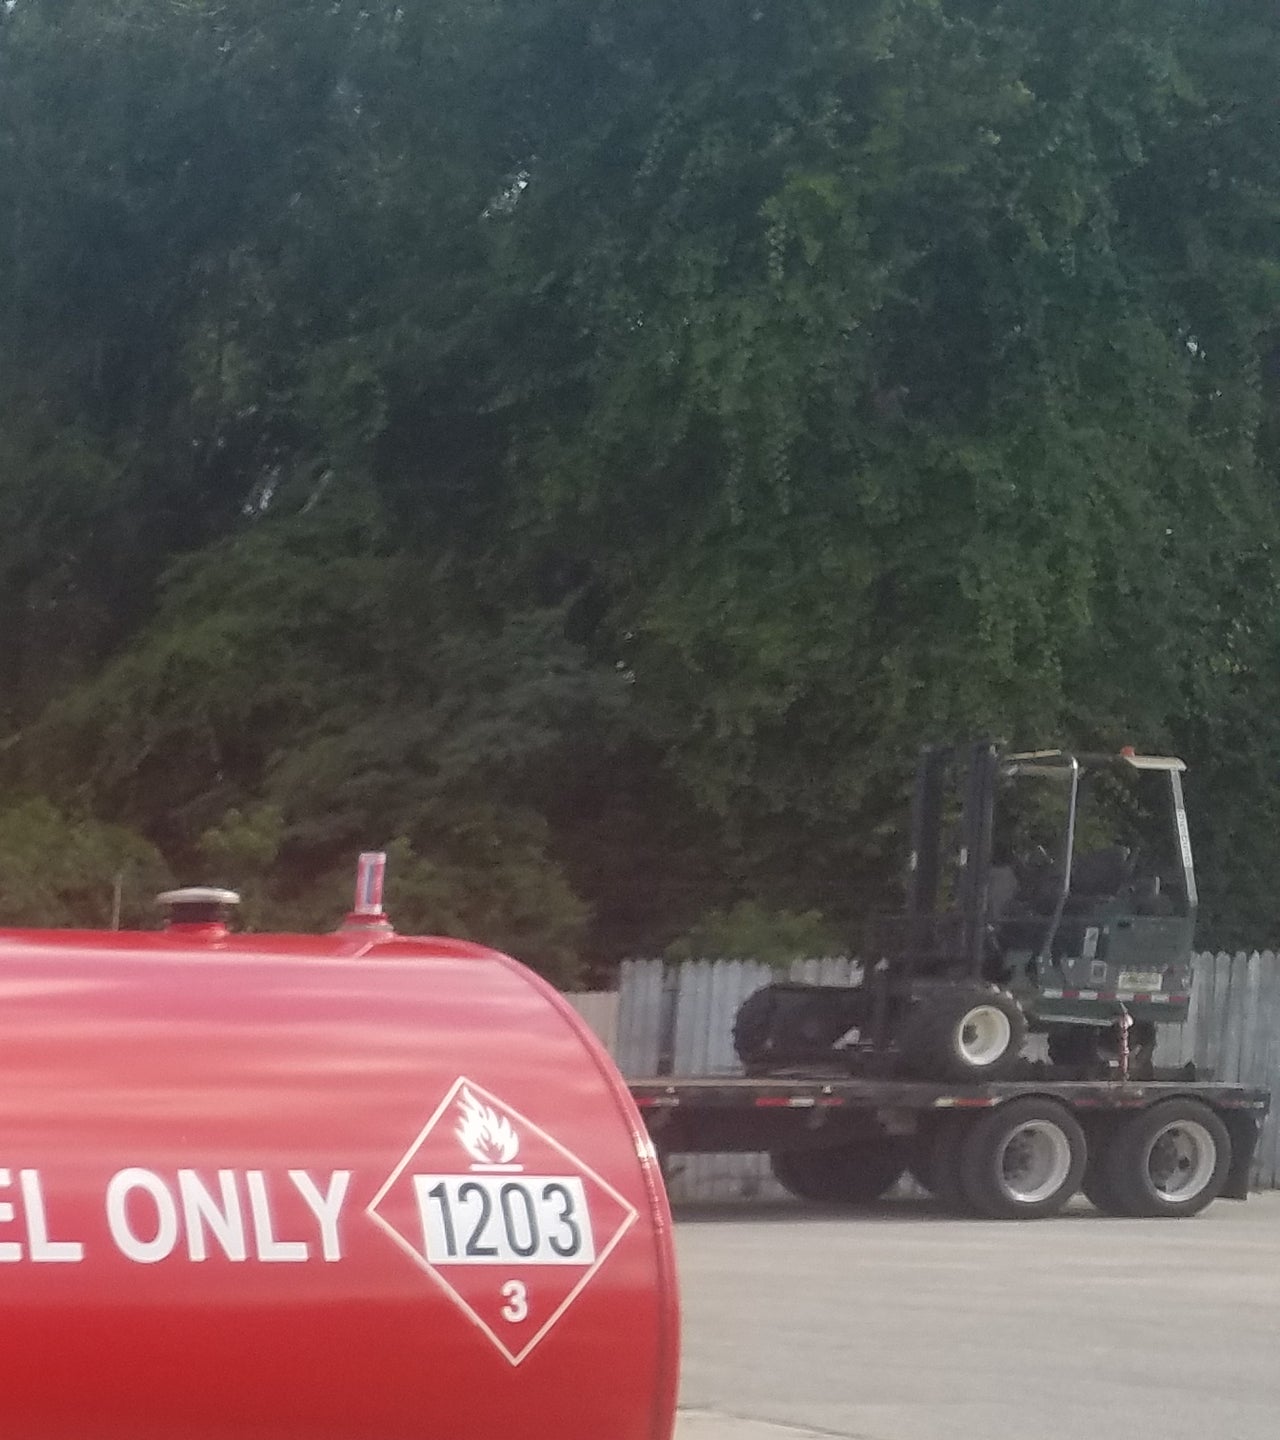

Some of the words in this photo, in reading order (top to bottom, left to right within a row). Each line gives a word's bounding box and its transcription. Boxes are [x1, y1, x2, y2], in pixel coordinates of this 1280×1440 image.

[106, 1167, 352, 1264] ONLY
[428, 1181, 583, 1258] 1203
[500, 1279, 529, 1323] 3
